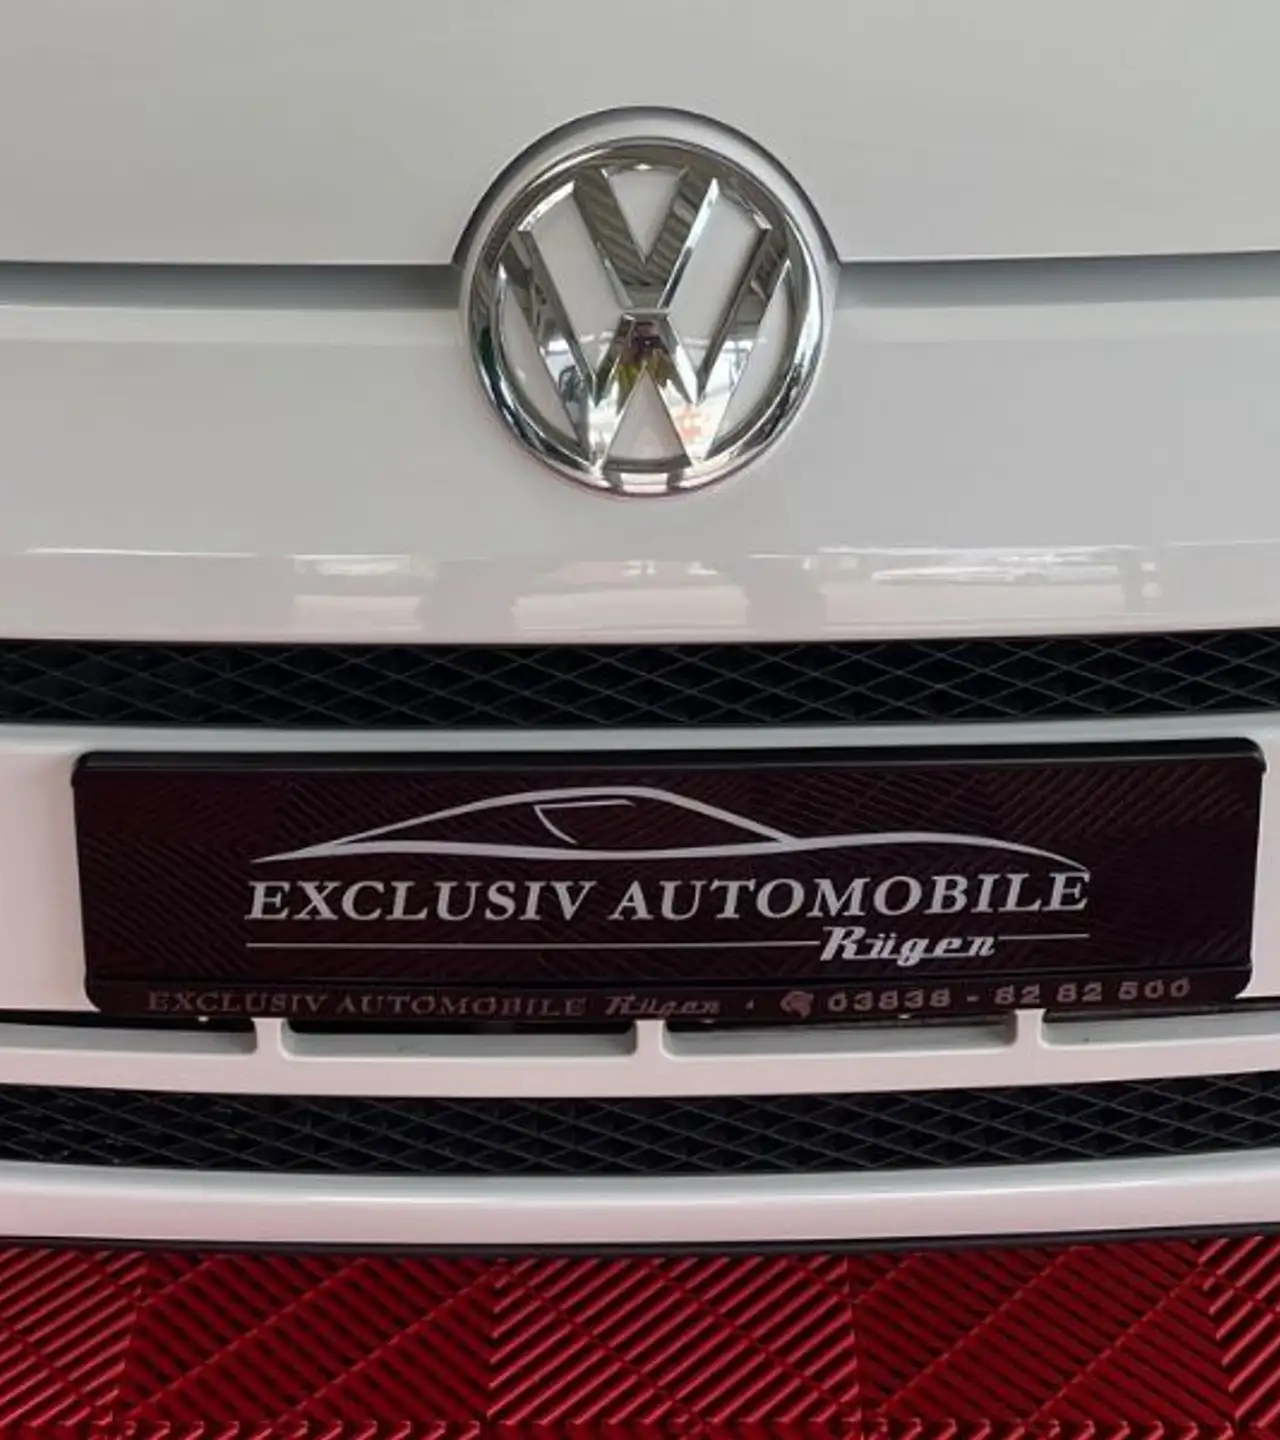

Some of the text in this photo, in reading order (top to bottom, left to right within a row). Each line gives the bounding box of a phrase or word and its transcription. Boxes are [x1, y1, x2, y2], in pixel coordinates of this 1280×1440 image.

[245, 871, 1092, 922] EXCLUSIV AUTOMOBILE
[818, 924, 997, 967] Rügen
[147, 990, 328, 1013] EXCLUSIV
[336, 993, 587, 1017] AUTOMOBILE
[827, 989, 952, 1013] 03838
[994, 984, 1041, 1006] 82
[1056, 981, 1102, 1002] 82
[1117, 977, 1192, 1000] 500
